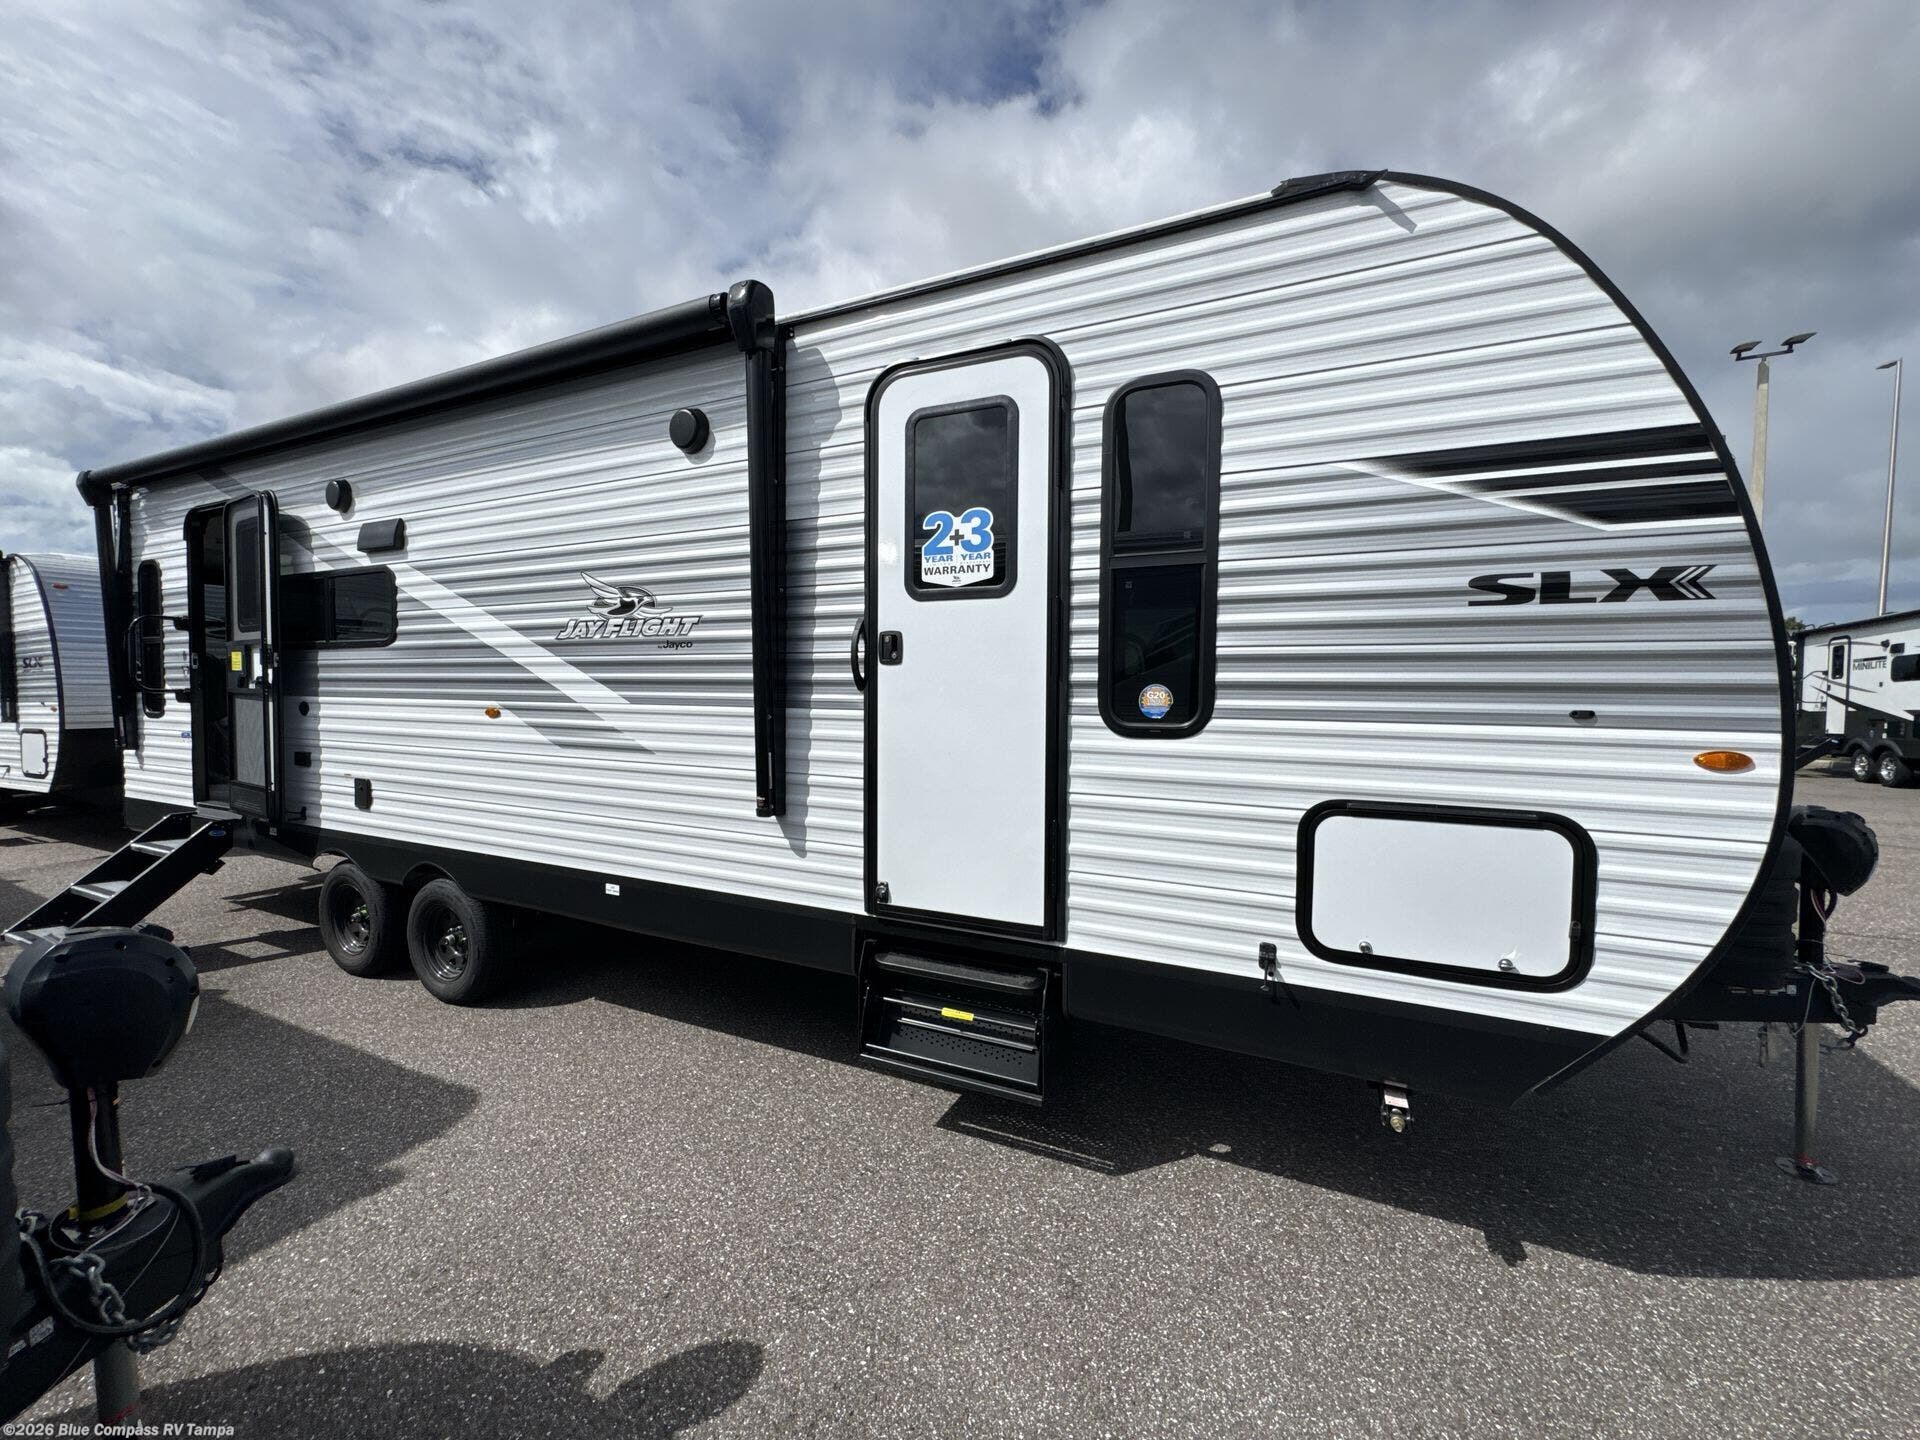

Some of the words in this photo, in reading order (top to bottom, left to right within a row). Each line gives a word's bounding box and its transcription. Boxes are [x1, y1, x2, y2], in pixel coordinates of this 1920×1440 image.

[924, 555, 953, 563] YEAR
[960, 552, 991, 561] YEAR
[924, 564, 990, 576] WARRANTY
[1467, 565, 1718, 606] SLX
[556, 618, 603, 640] JAY
[601, 615, 703, 638] FLIGHT
[663, 640, 693, 650] Jayco
